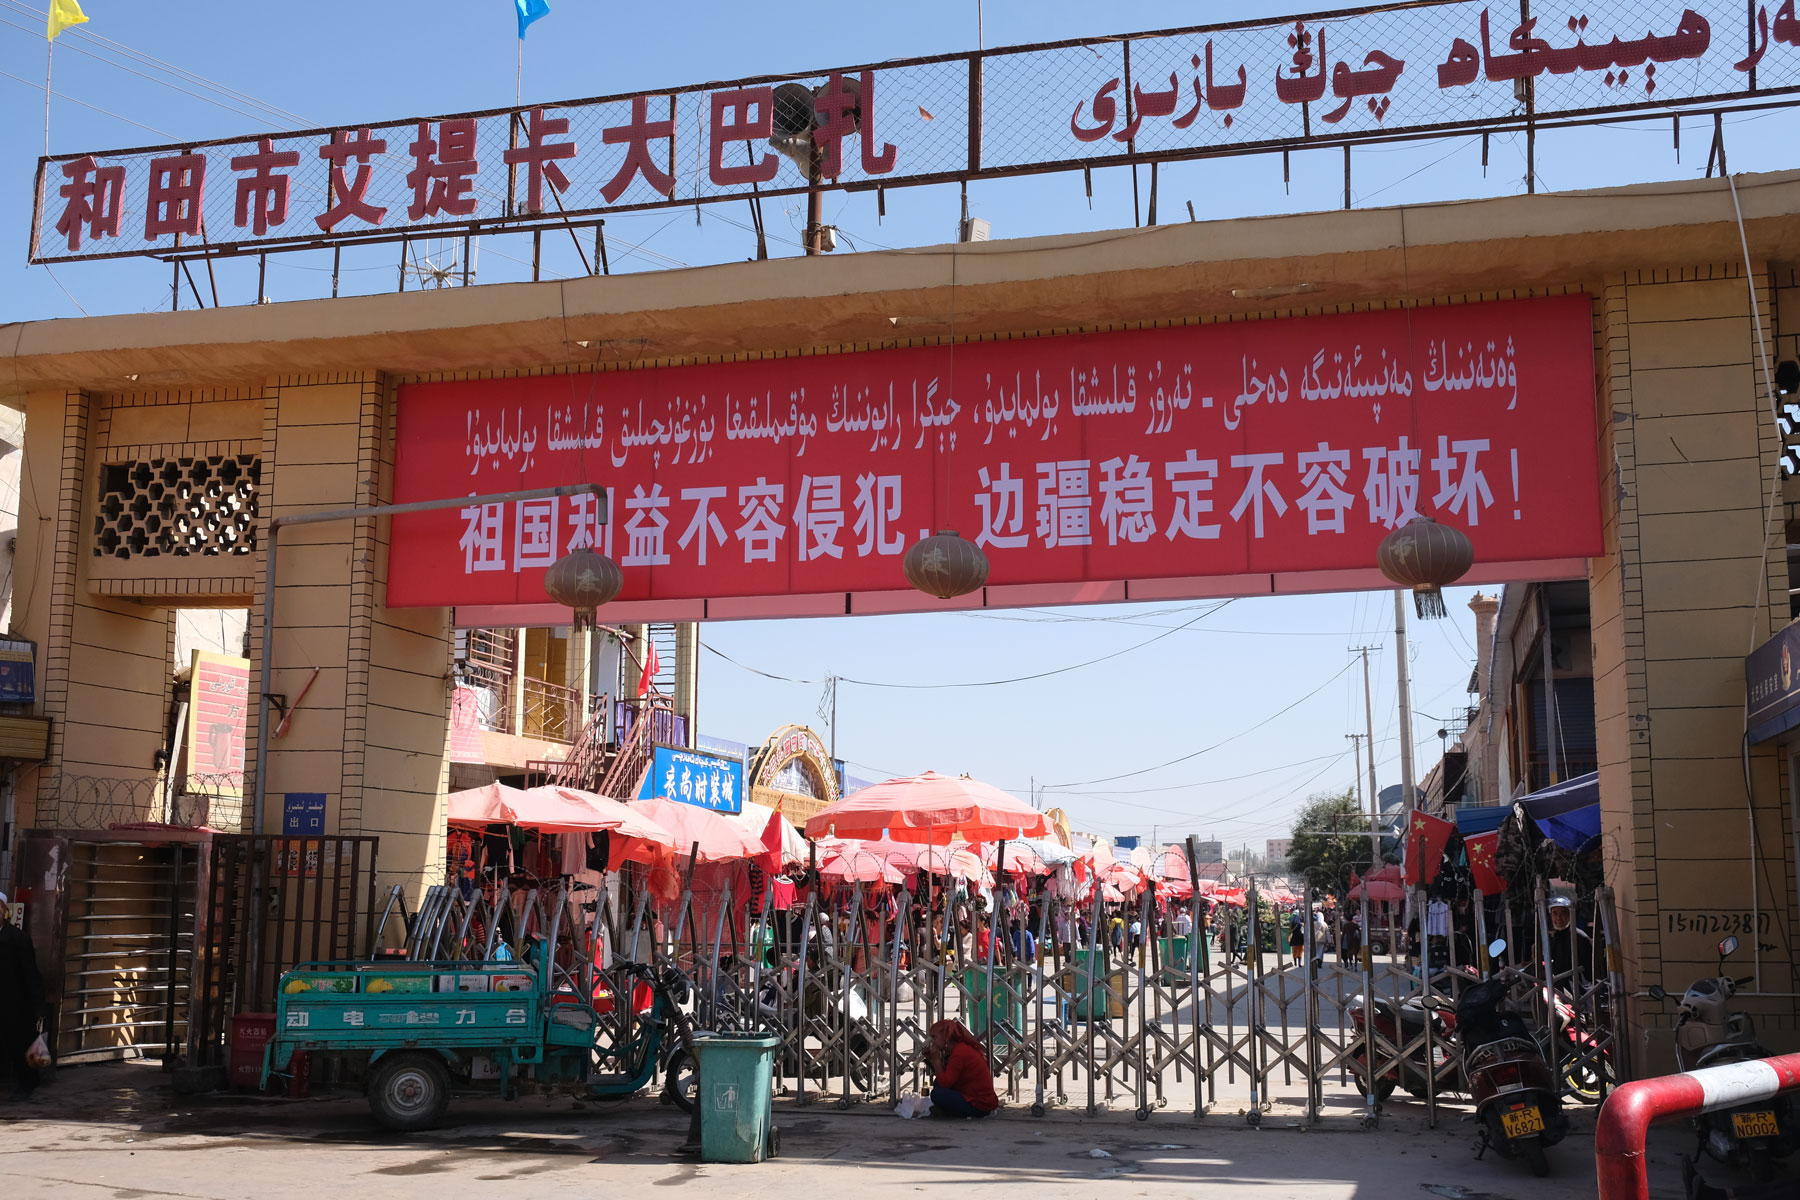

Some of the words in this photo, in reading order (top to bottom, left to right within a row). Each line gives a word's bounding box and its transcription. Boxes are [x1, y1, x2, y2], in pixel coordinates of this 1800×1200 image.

[1276, 20, 1405, 123] چوڭ
[56, 69, 899, 252] 和田市艾提卡大巴扎
[290, 816, 319, 828] 出口
[1507, 1118, 1541, 1137] V6827
[1736, 1122, 1777, 1137] N0002
